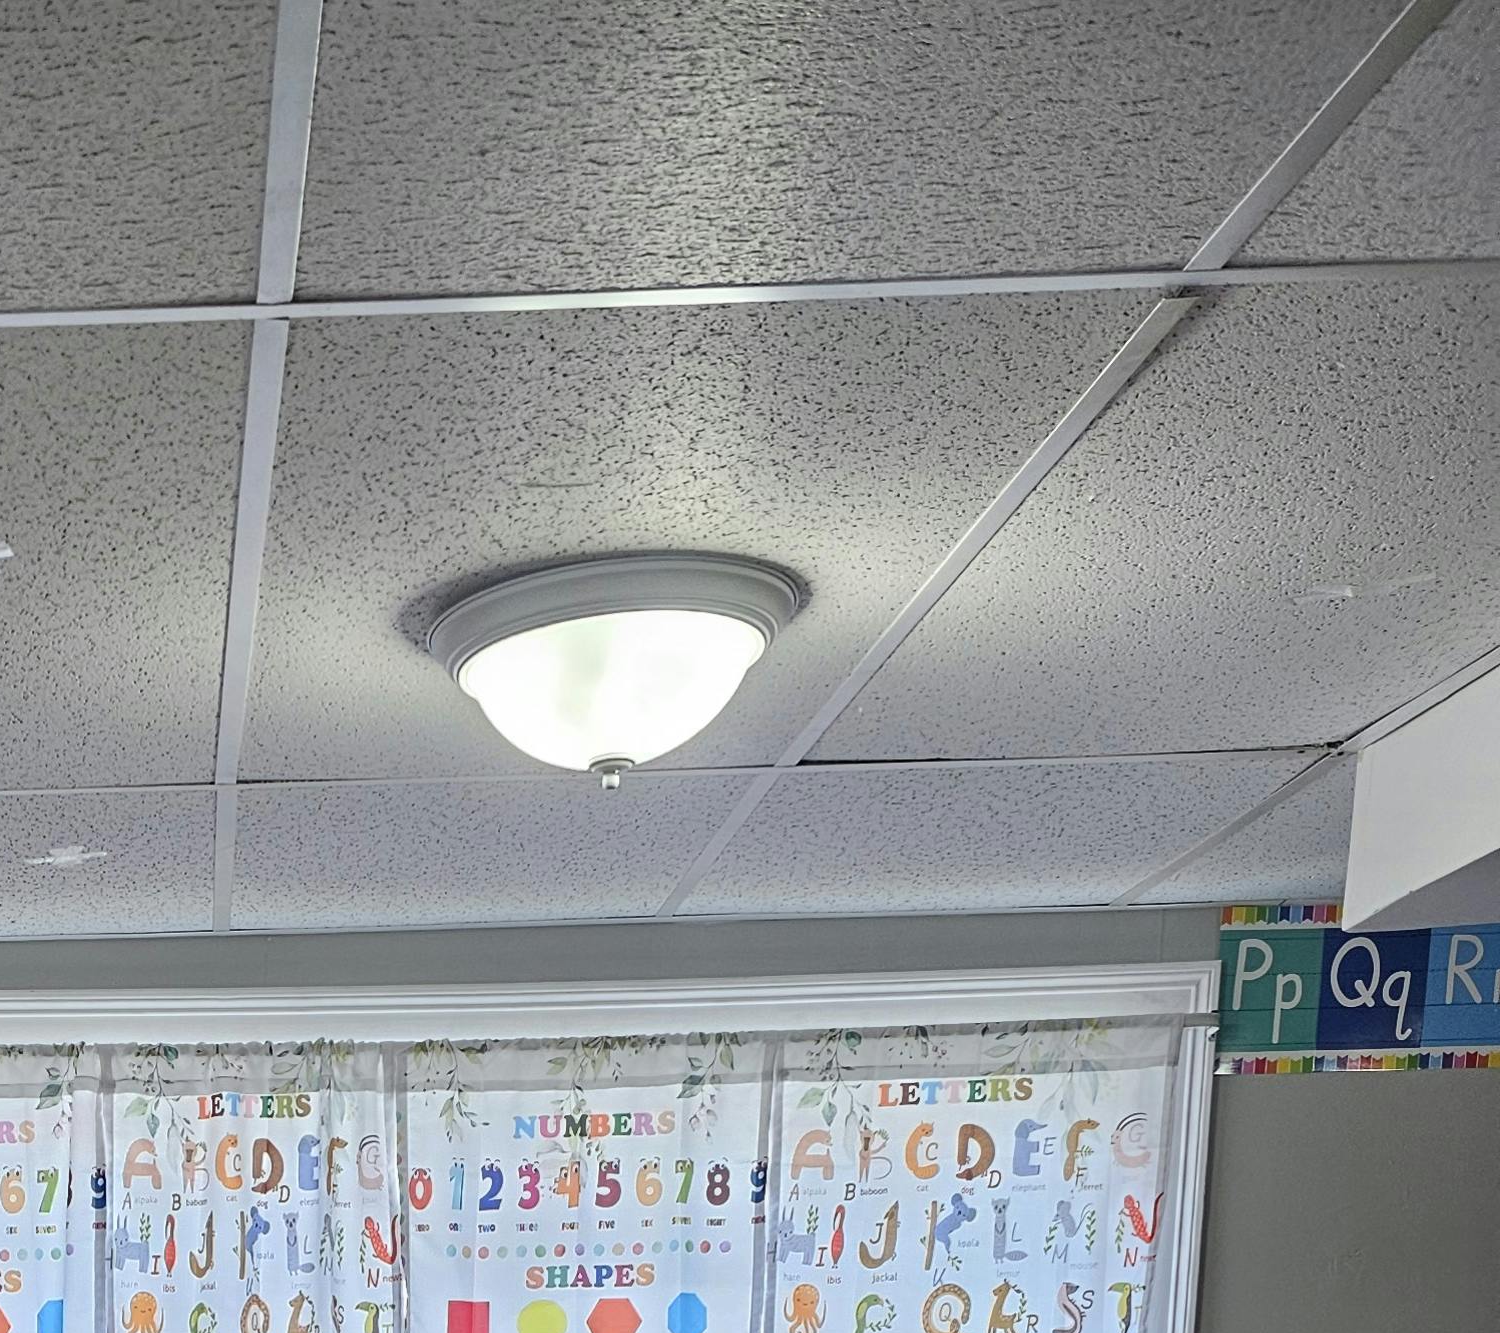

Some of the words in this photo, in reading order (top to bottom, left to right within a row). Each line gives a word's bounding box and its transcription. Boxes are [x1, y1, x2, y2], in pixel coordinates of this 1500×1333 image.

[1232, 938, 1303, 1044] Pp
[1330, 936, 1412, 1041] Qq
[197, 1092, 312, 1120] LETTERS
[878, 1077, 1033, 1108] LETTERS
[512, 1110, 676, 1140] NUMBERS
[0, 1166, 26, 1215] 6
[36, 1167, 60, 1214] 7
[409, 1167, 433, 1211] 0
[449, 1161, 465, 1211] 1
[478, 1162, 503, 1212] 2
[517, 1162, 541, 1210] 3
[556, 1159, 581, 1209] 4
[594, 1160, 622, 1209] 5
[635, 1160, 663, 1207] 6
[675, 1159, 695, 1204] 7
[705, 1162, 731, 1207] 8
[525, 1263, 656, 1290] SHAPES
